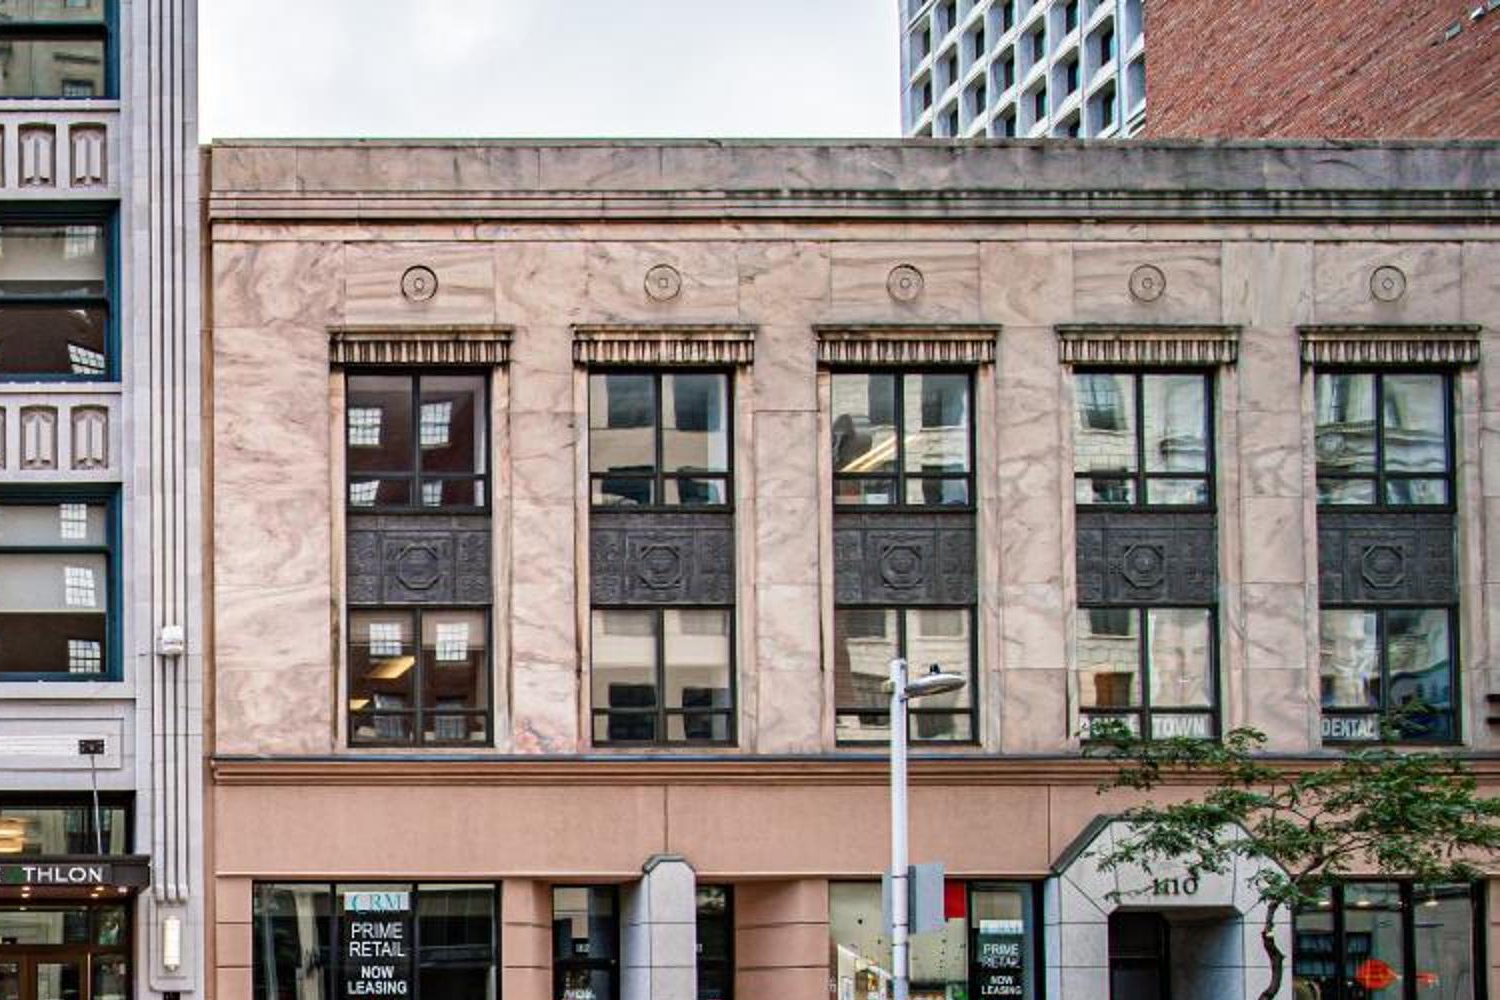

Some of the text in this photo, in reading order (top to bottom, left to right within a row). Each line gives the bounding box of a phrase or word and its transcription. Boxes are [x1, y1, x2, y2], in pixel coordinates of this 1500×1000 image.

[351, 922, 403, 939] PRIME
[349, 941, 406, 957] RETAIL
[983, 943, 1019, 955] PRIME
[361, 965, 395, 979] NOW
[990, 975, 1013, 985] NOW
[347, 980, 407, 995] LEASING
[981, 985, 1022, 995] LEASING
